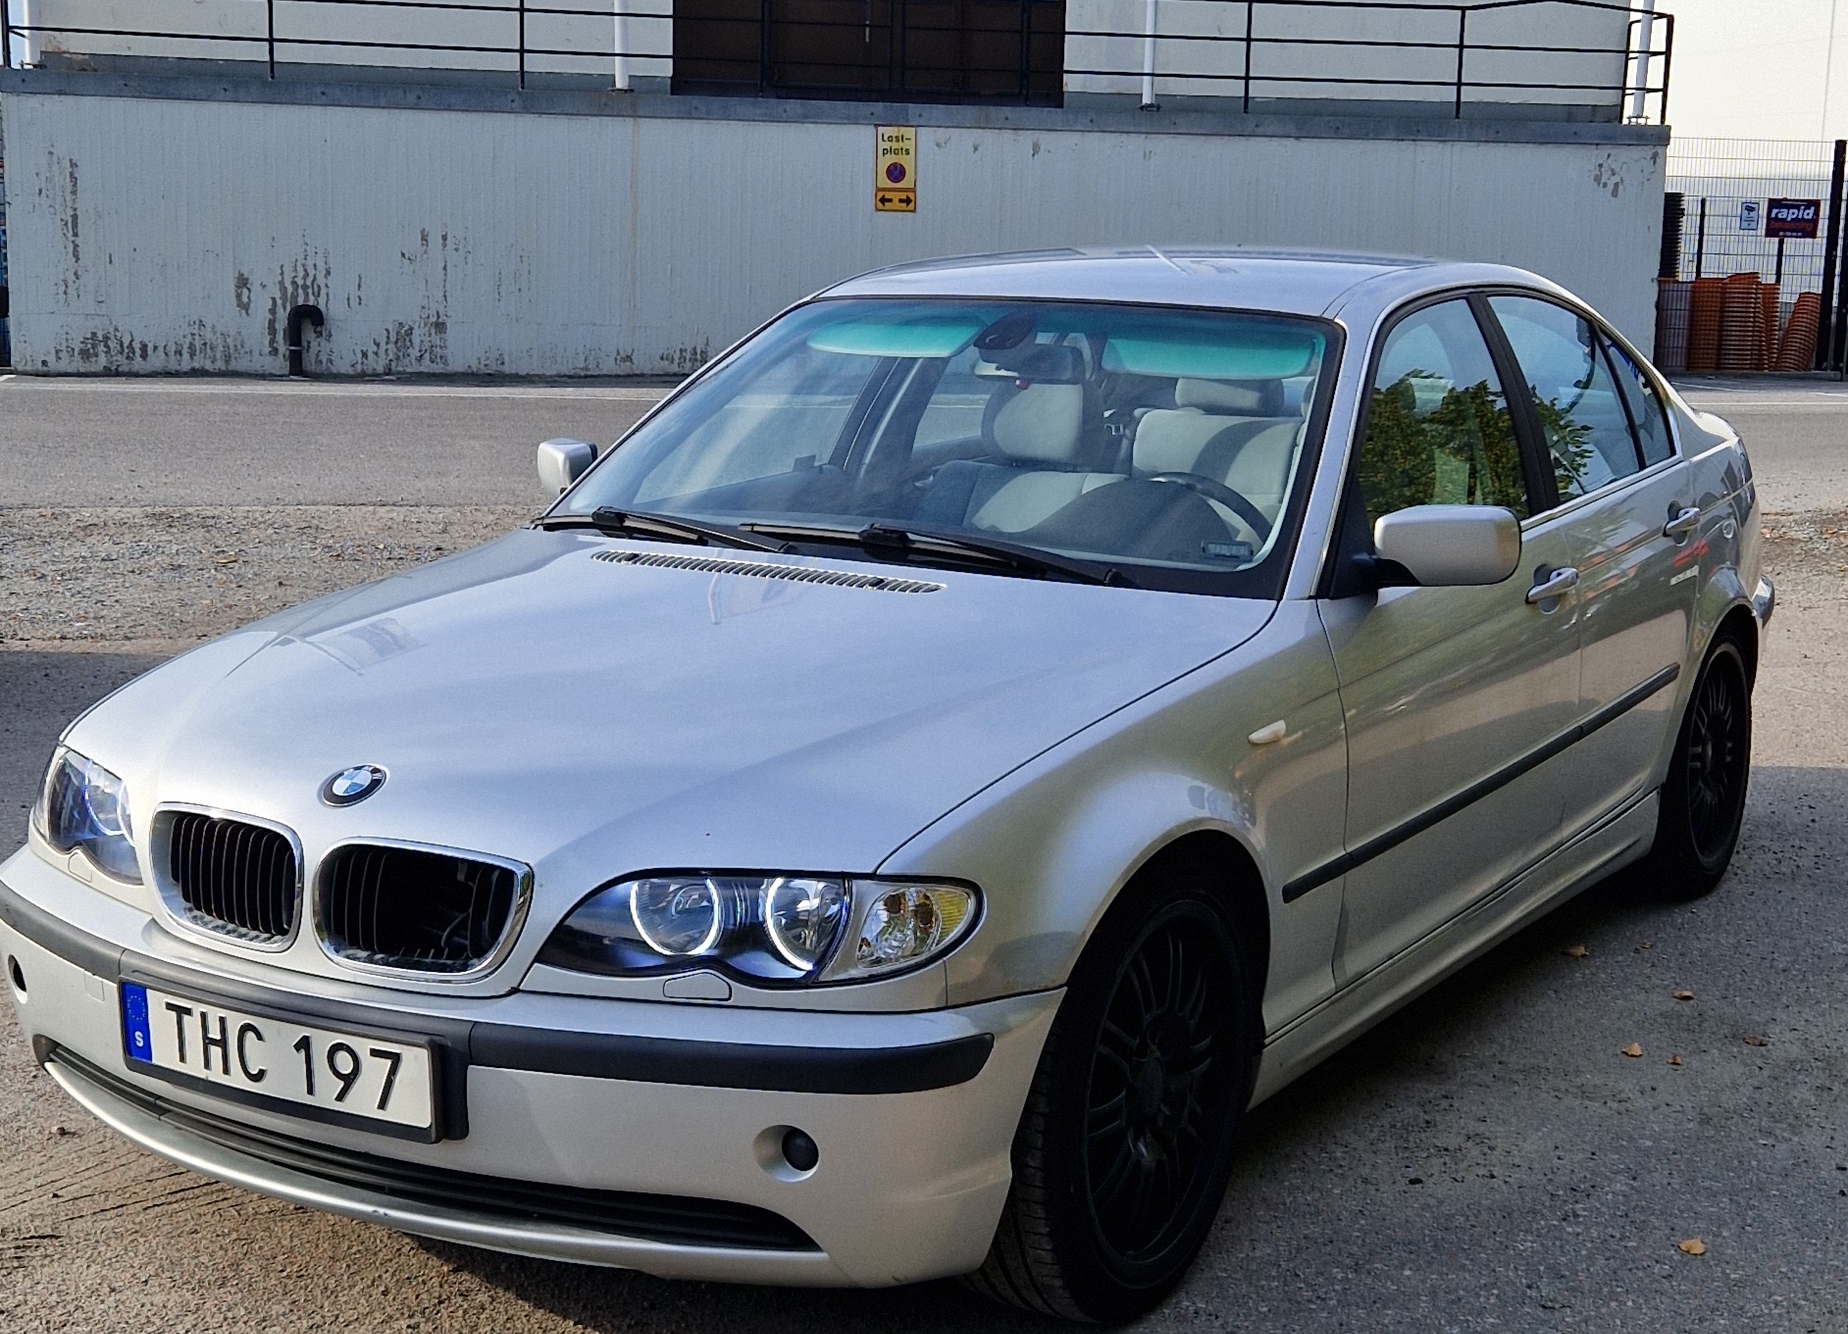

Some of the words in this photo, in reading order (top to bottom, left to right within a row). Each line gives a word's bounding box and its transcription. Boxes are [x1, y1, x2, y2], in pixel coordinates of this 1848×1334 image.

[881, 132, 911, 143] Last-
[882, 145, 910, 158] plats
[1770, 205, 1815, 221] rapid
[134, 1031, 144, 1048] S
[164, 1001, 268, 1084] THC
[293, 1034, 403, 1111] 197
